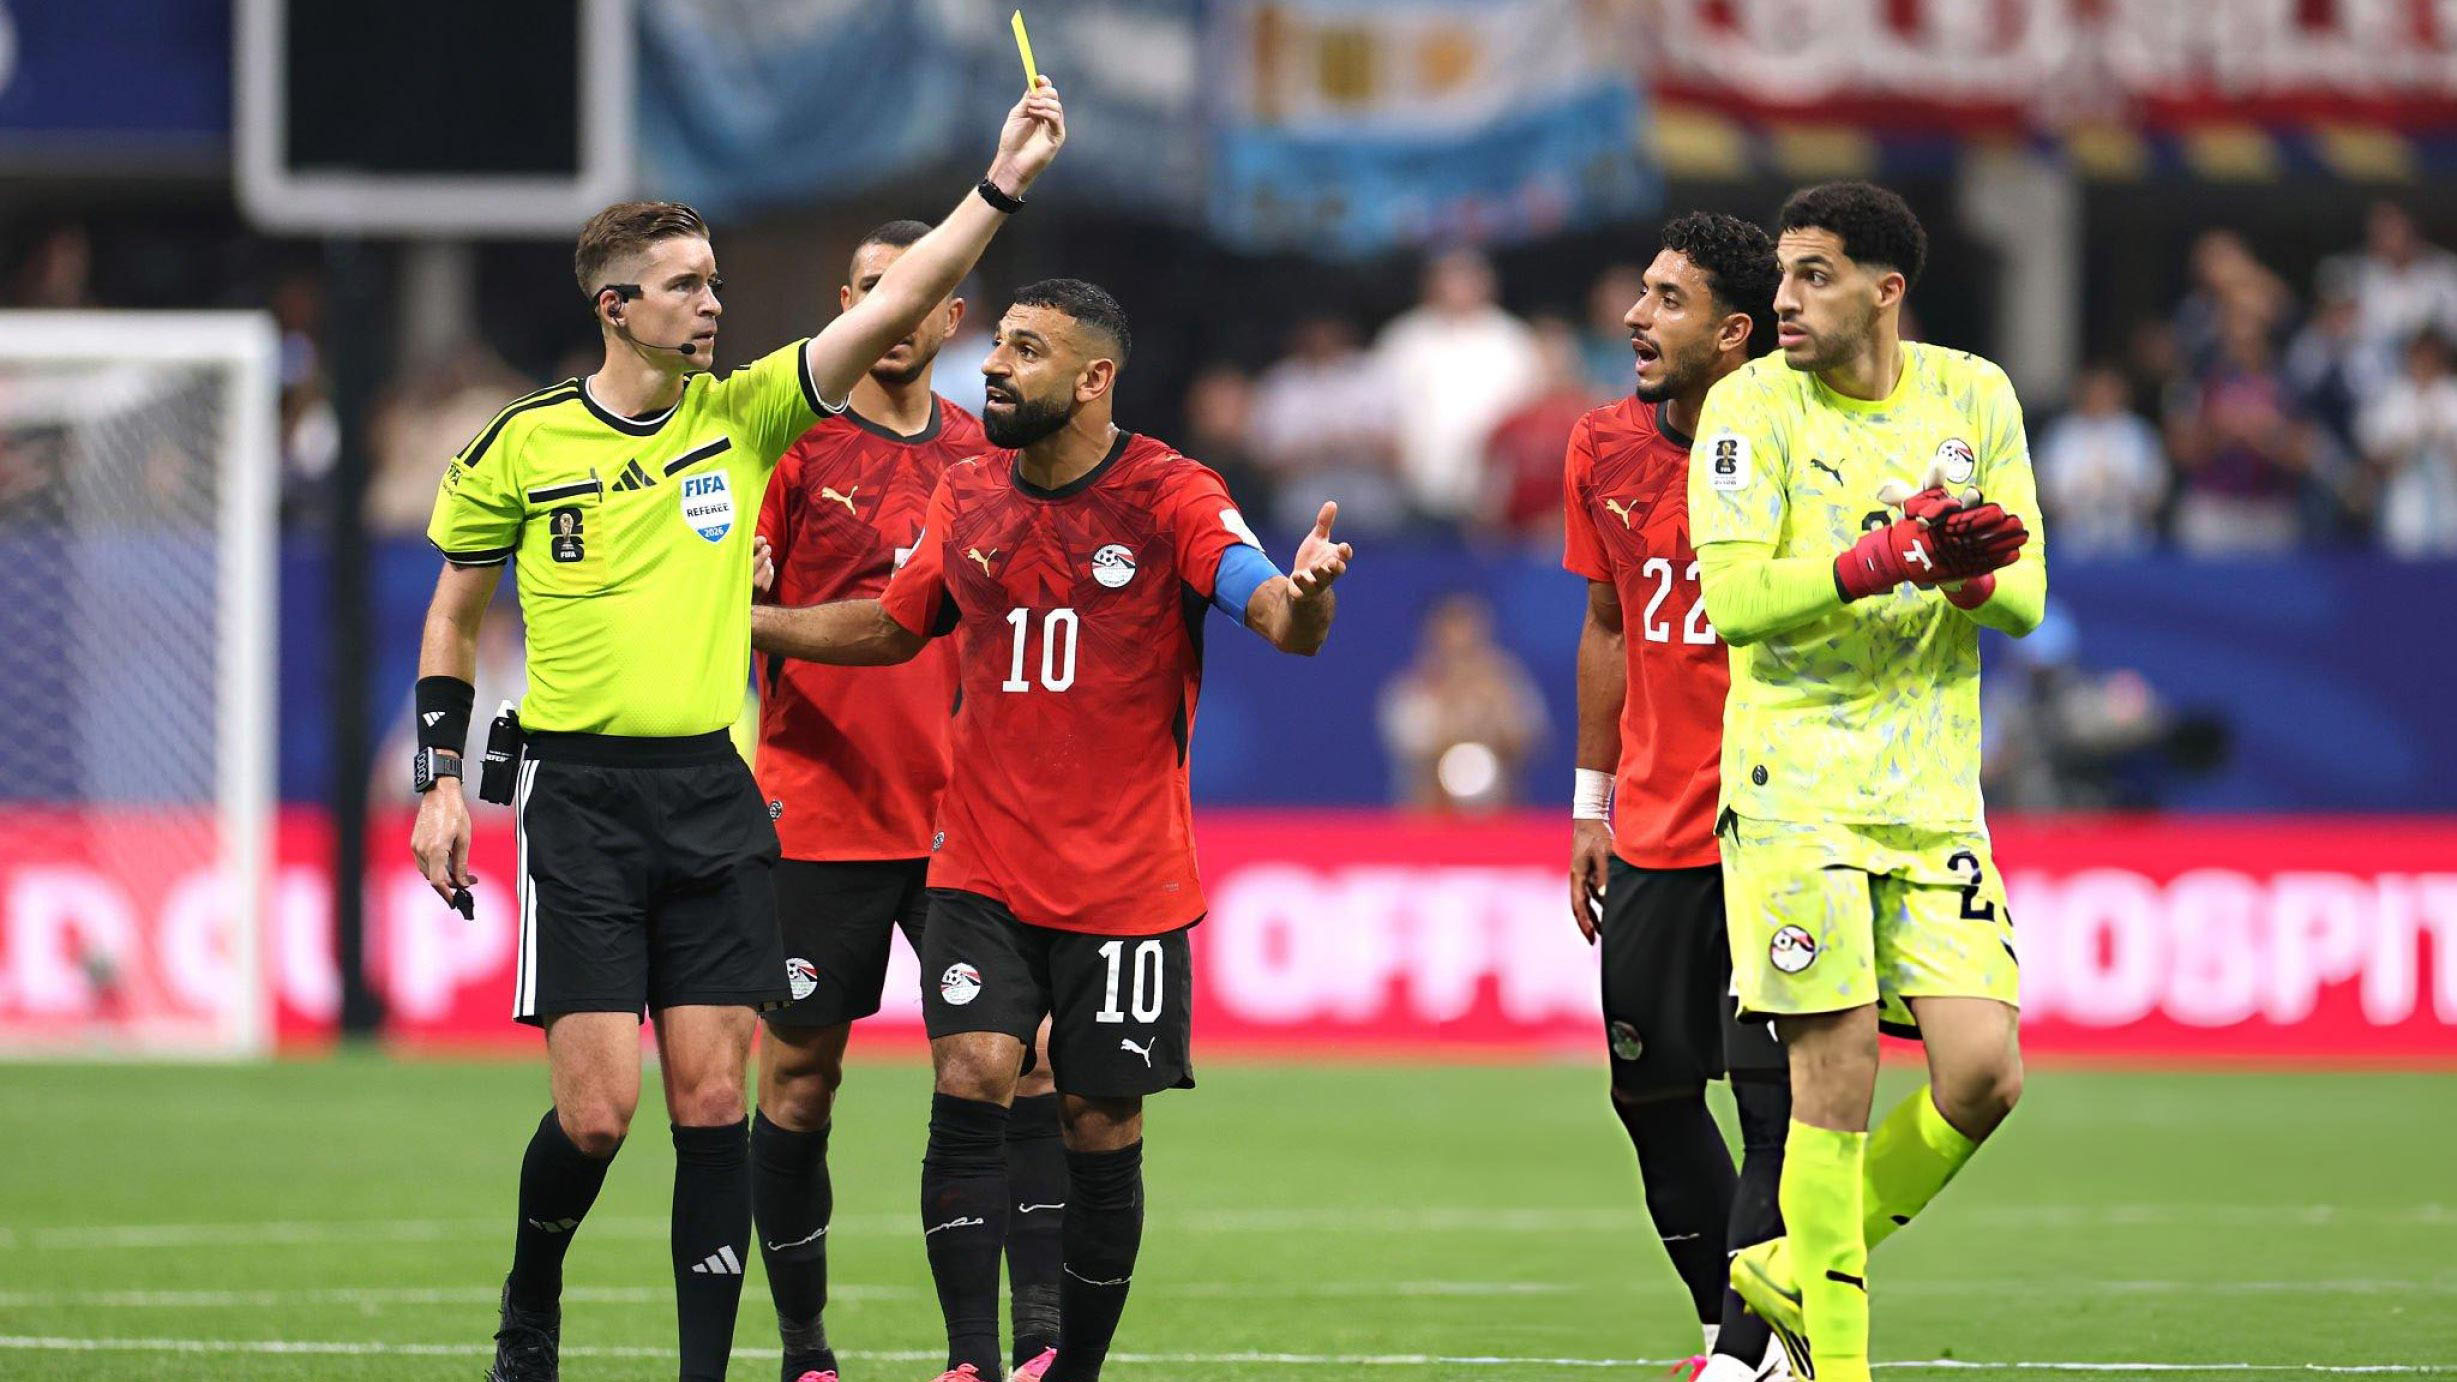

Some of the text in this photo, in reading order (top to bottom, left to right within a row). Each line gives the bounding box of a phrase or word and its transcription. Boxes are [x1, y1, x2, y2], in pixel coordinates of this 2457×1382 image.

[685, 475, 725, 497] FIFA
[686, 503, 730, 517] REFEREE
[703, 526, 724, 538] 2026
[1643, 557, 1717, 645] 22
[1002, 607, 1079, 692] 10
[1946, 850, 2014, 928] 2
[1095, 939, 1164, 1023] 10
